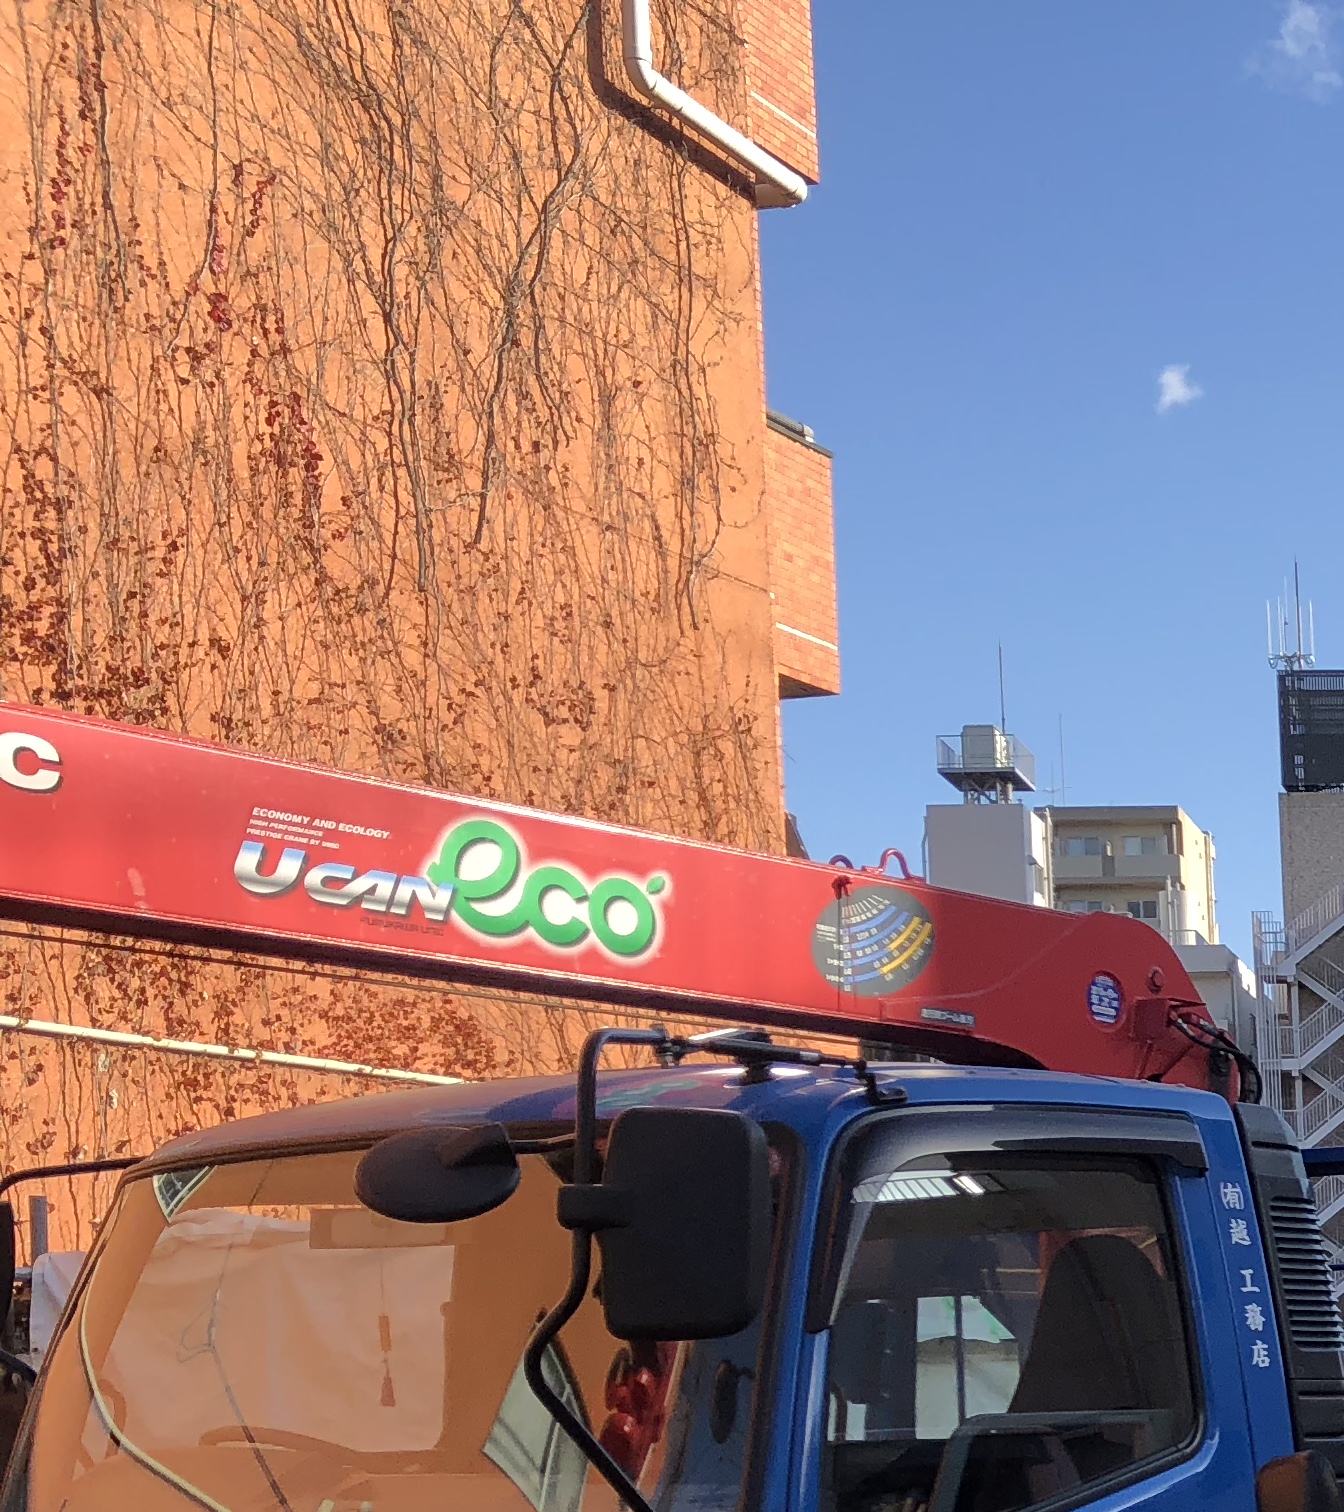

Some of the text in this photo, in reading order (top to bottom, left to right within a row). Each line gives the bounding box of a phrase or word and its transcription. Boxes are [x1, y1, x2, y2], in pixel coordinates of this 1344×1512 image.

[252, 807, 391, 840] ECONOMY AND ECOLOGY
